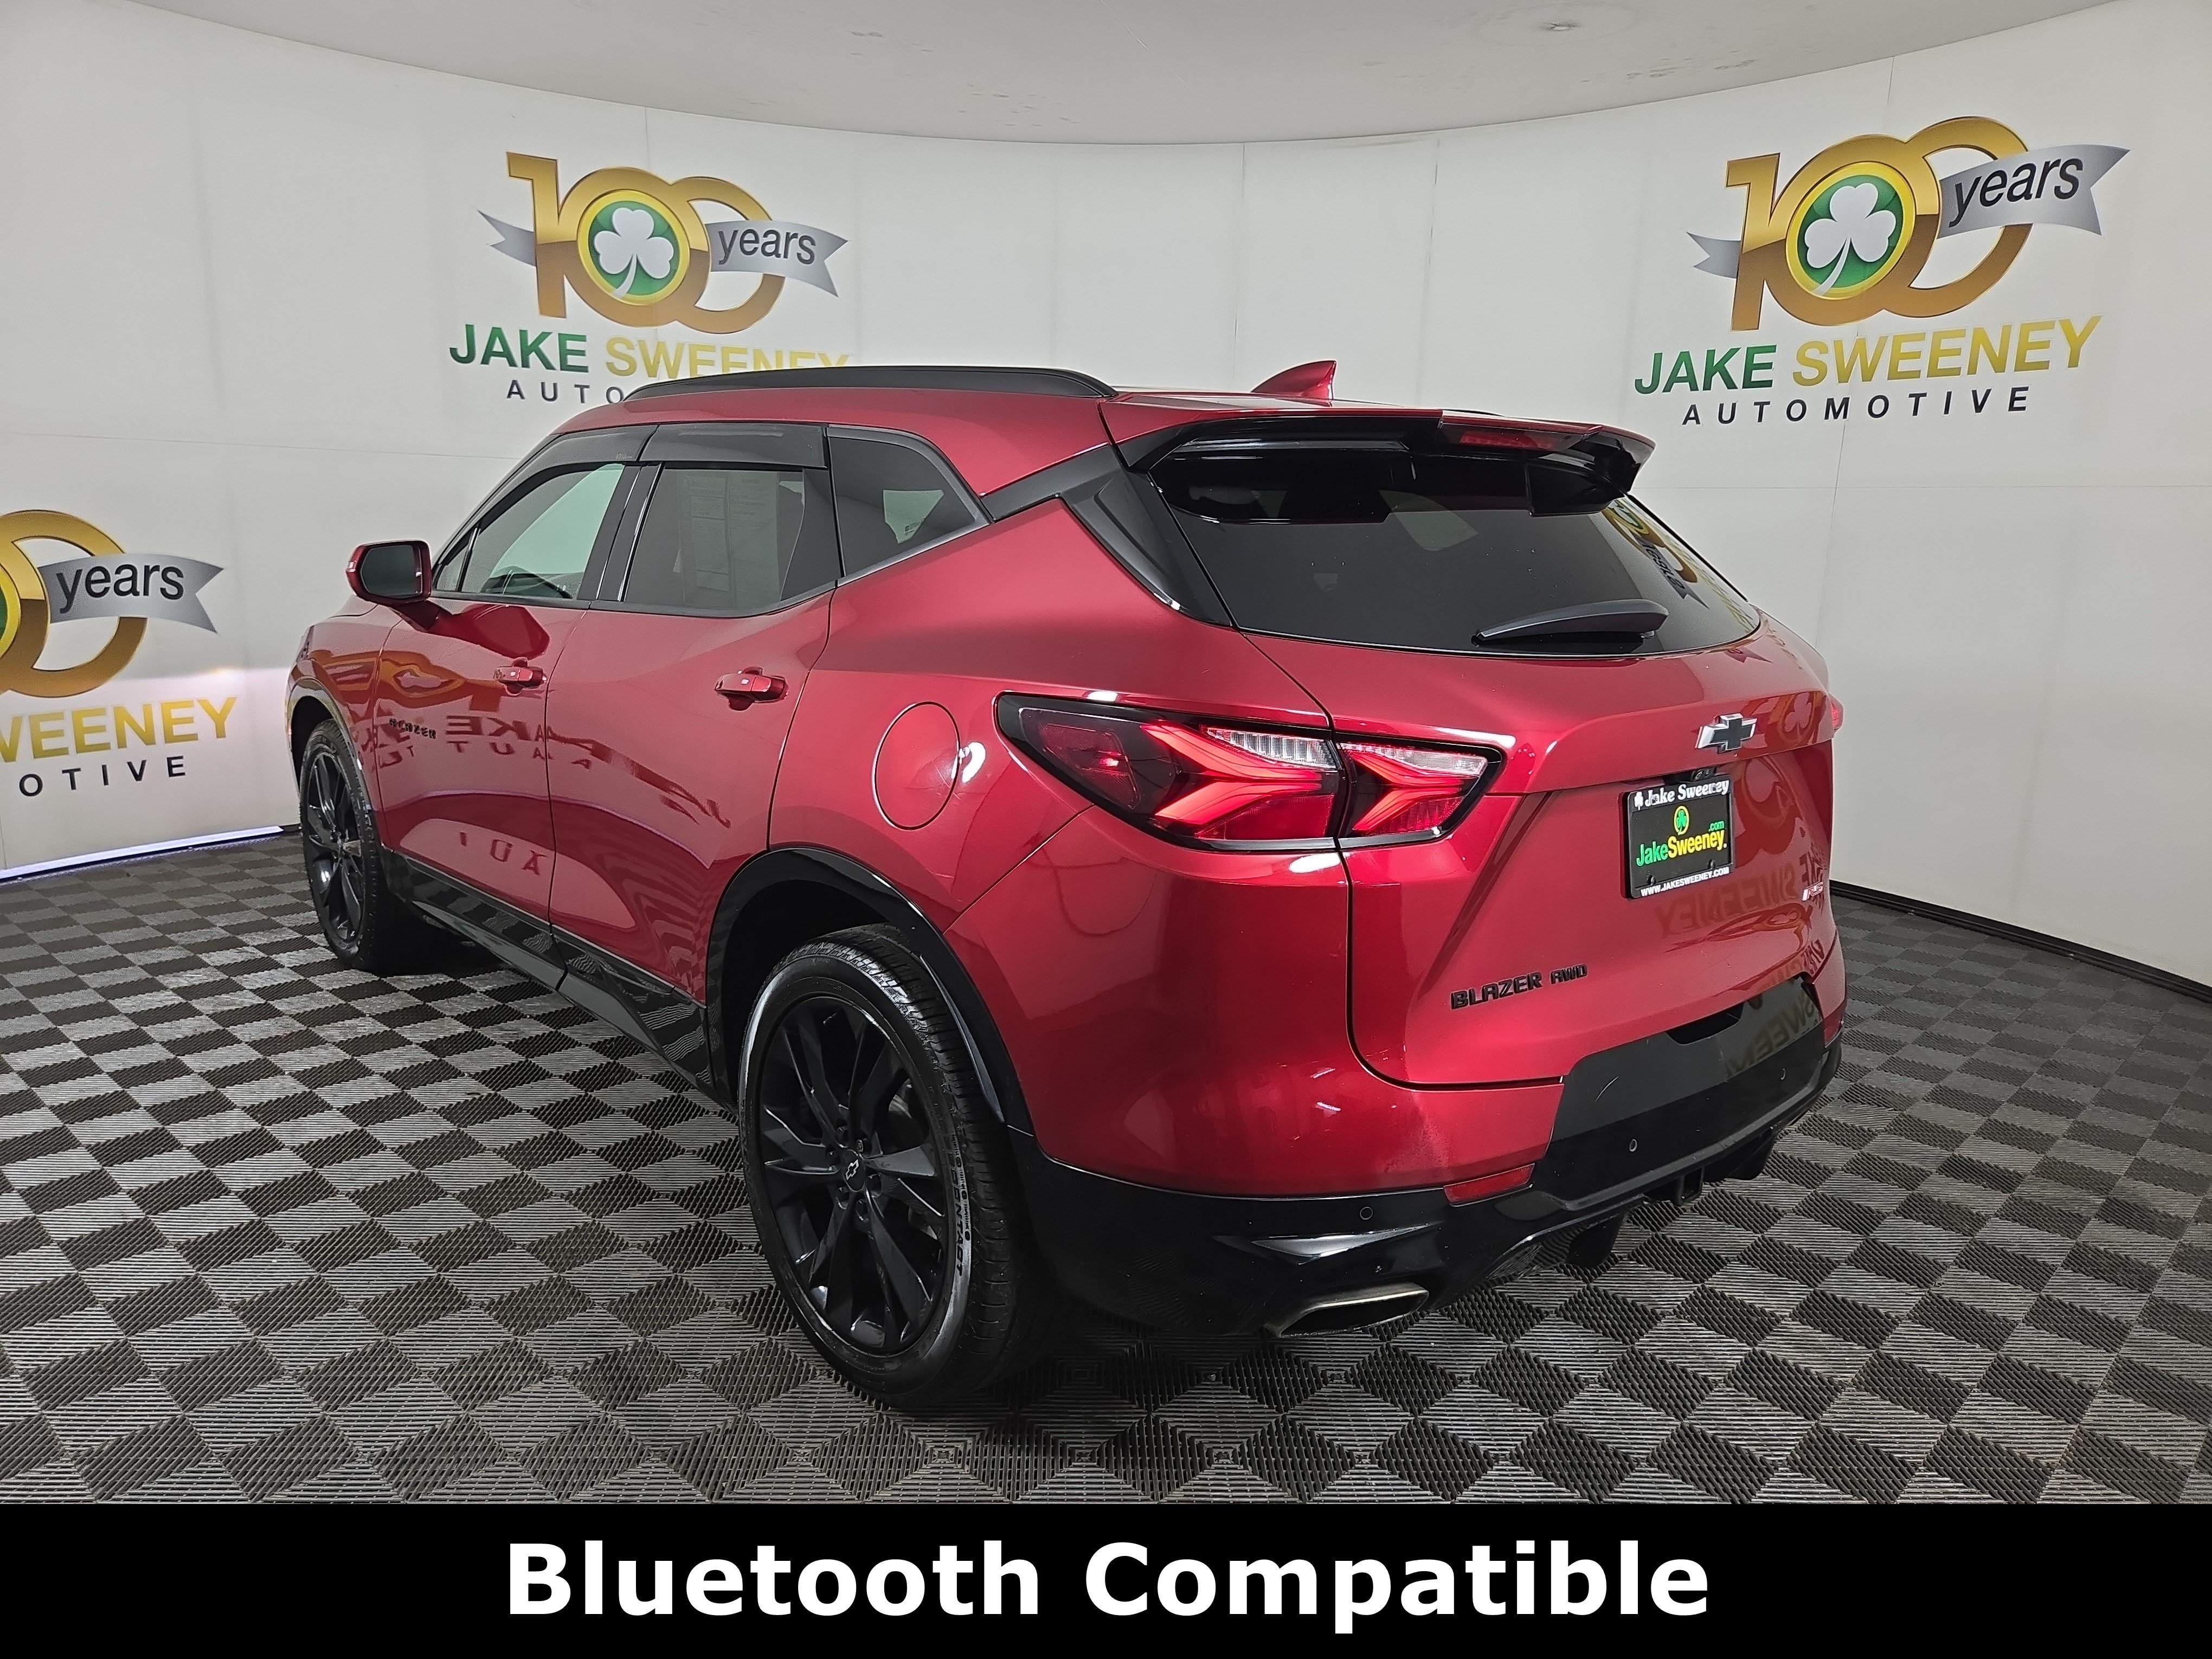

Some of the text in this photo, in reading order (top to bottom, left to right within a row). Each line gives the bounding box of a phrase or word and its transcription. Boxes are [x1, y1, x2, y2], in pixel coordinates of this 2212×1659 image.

[1948, 157, 2084, 228] years
[718, 229, 816, 265] years
[449, 324, 589, 372] JAKE
[1634, 315, 2103, 394] JAKE SWEENEY
[1682, 385, 2030, 426] AUTOMOTIVE
[56, 563, 184, 614] years
[1641, 866, 1729, 897] WWW.JAKESWEENEY.COM
[1450, 963, 1588, 1009] BLAZER AWD
